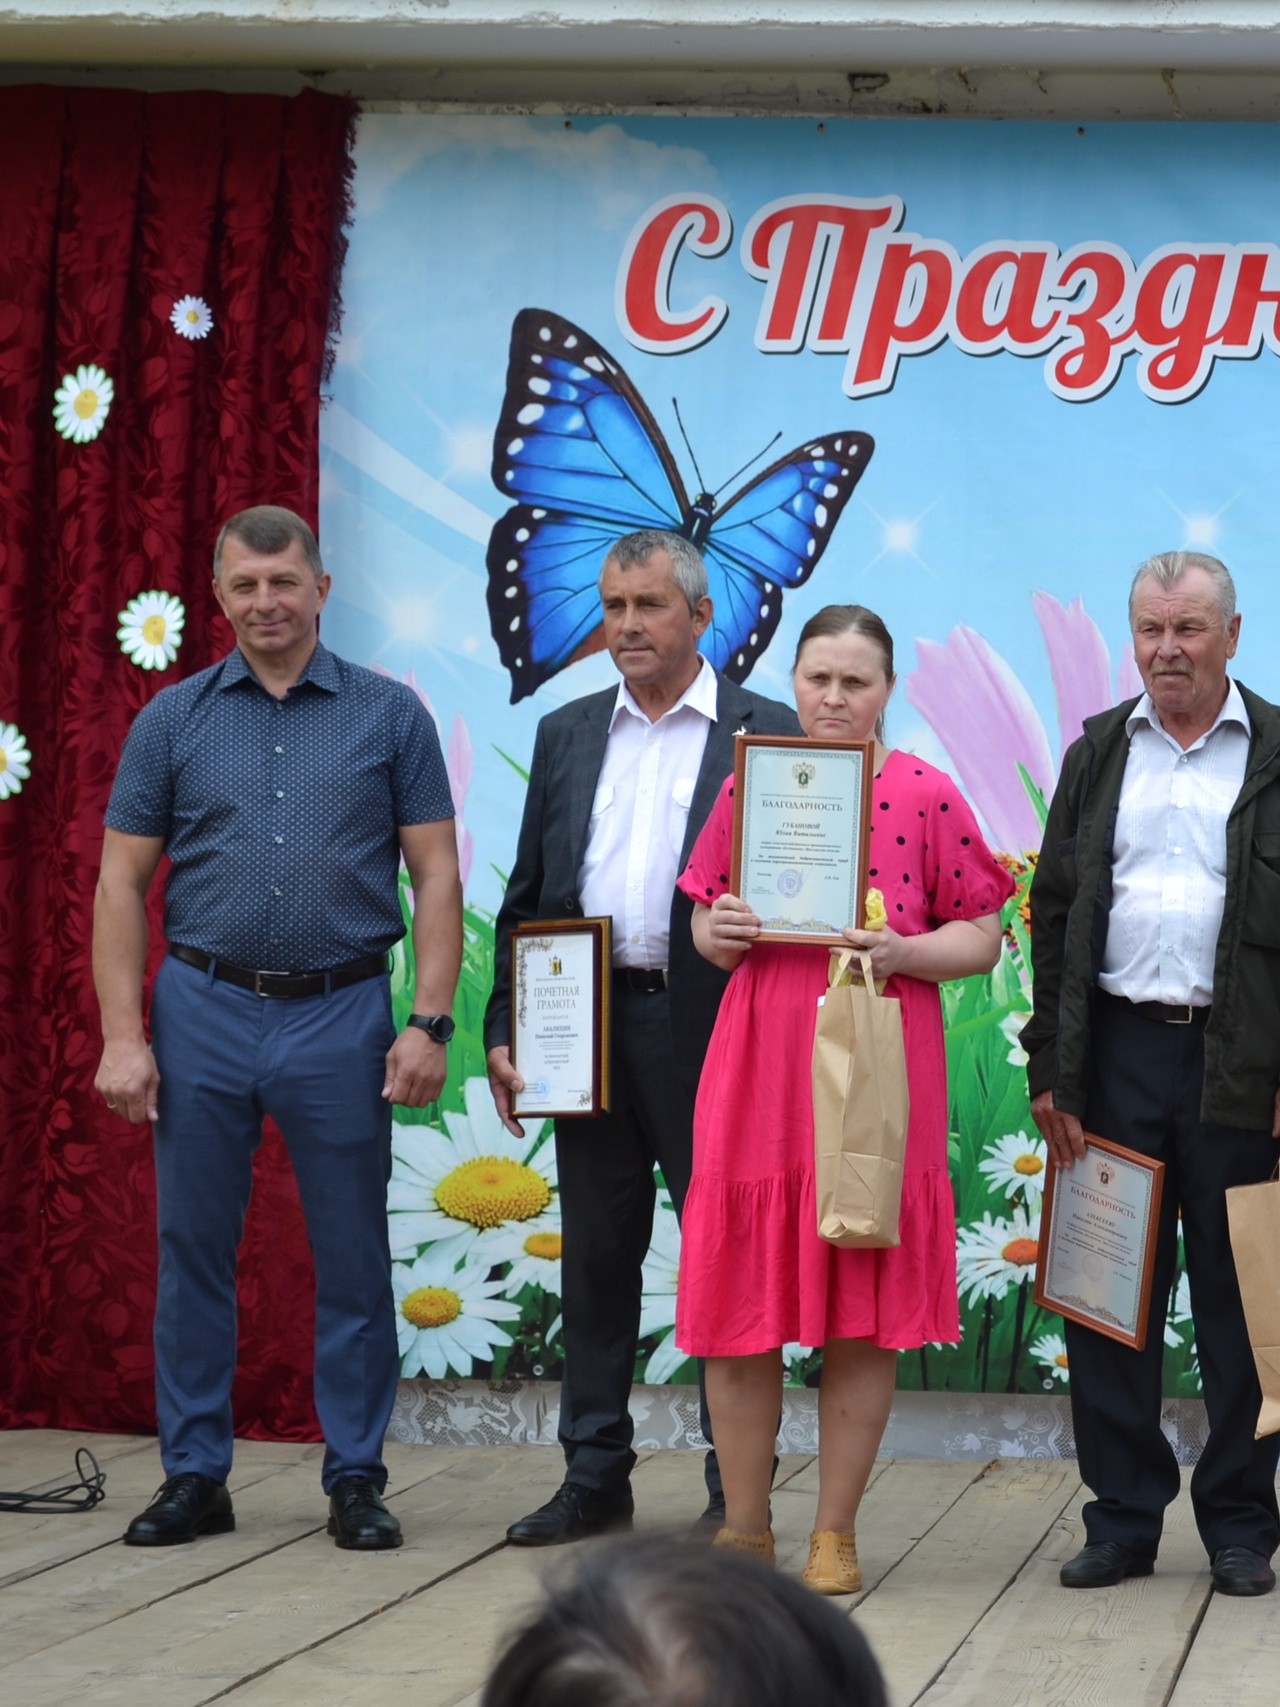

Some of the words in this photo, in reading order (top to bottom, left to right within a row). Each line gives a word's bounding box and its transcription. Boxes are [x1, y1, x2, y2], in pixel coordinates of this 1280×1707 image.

[614, 193, 731, 351] С
[762, 800, 843, 812] БЛАГОДАРНОСТЬ
[533, 986, 580, 997] ПОЧЕТНАЯ
[537, 999, 576, 1010] ГРАМОТА
[1070, 1186, 1136, 1220] БЛАГОДАРНОСТЬ
